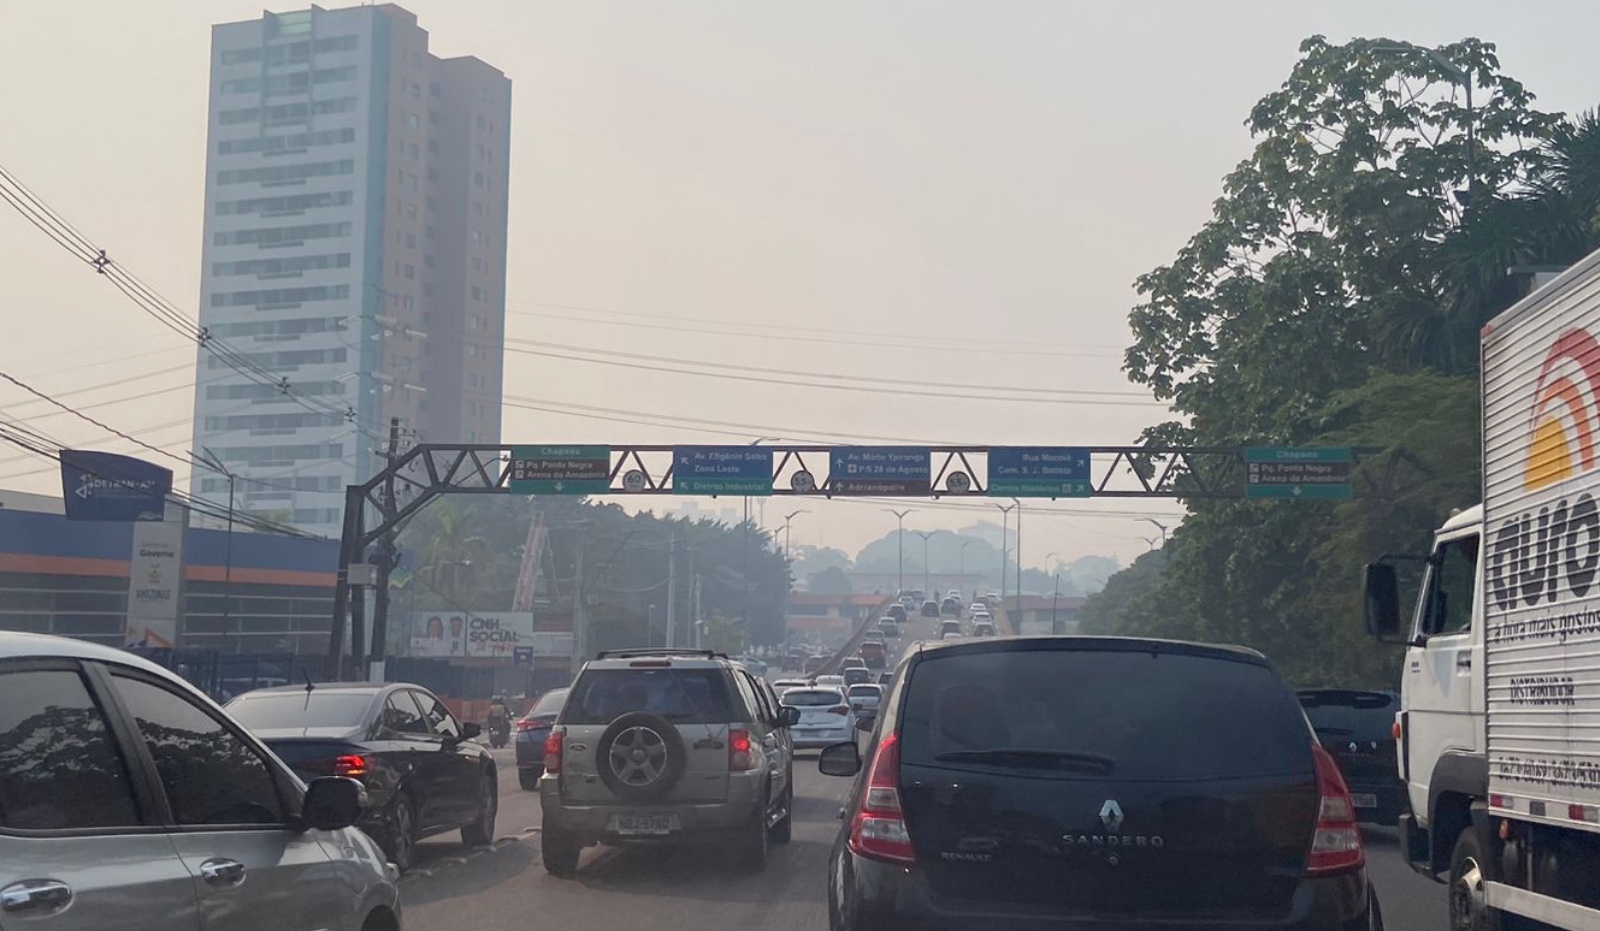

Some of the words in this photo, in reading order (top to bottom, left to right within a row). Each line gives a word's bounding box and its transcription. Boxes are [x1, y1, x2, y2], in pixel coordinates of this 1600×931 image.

[540, 447, 581, 457] Chapada
[745, 452, 768, 460] Sales
[1021, 453, 1040, 461] Rua
[888, 453, 925, 463] Ypiranga
[542, 460, 567, 469] Ponta
[568, 461, 592, 470] Negra
[694, 464, 715, 473] Zona
[717, 464, 740, 473] Leste
[885, 465, 898, 474] de
[898, 465, 929, 475] Agosto
[1277, 463, 1304, 472] Ponta
[1305, 463, 1333, 474] Negra
[526, 470, 552, 479] Arena
[553, 470, 564, 479] da
[628, 474, 642, 484] 60
[1261, 474, 1288, 483] Arena
[1288, 474, 1301, 483] da
[725, 481, 765, 491] Industrial
[469, 618, 500, 630] CNH
[469, 630, 520, 642] SOCIAL
[1062, 834, 1165, 848] SANDERO
[941, 851, 992, 862] RENAULT
